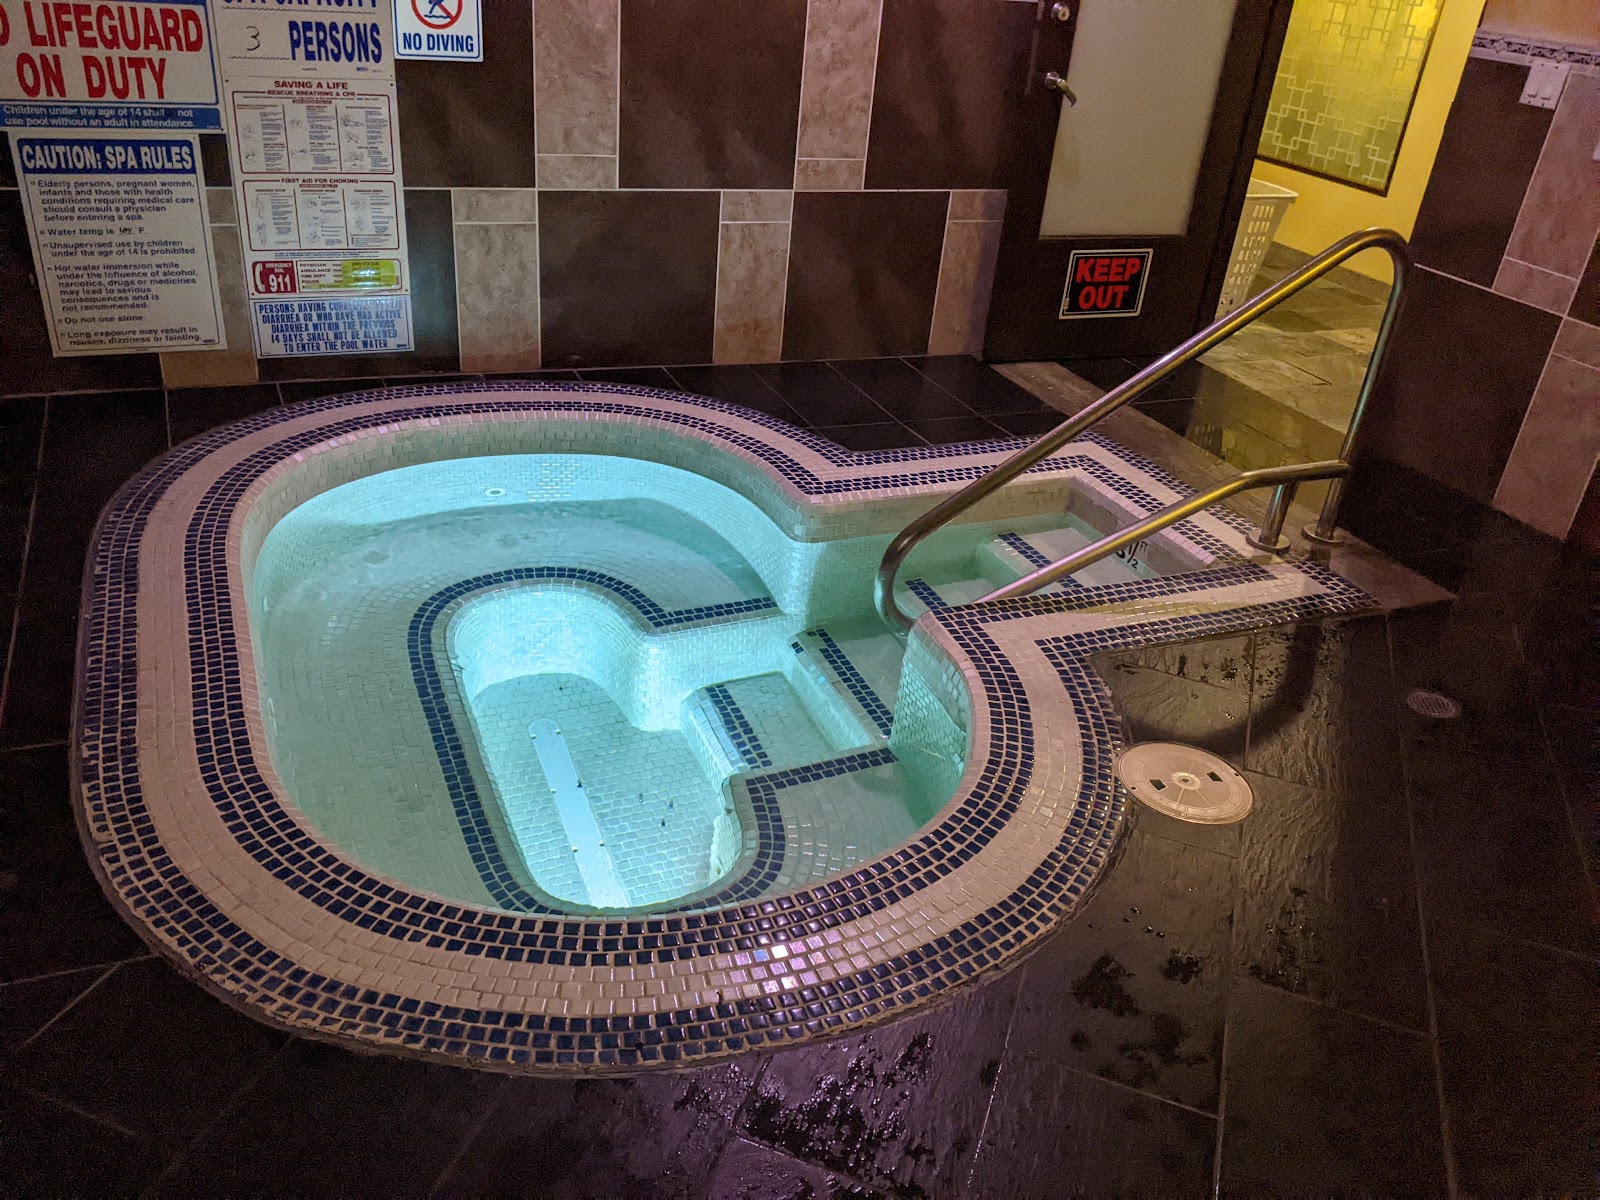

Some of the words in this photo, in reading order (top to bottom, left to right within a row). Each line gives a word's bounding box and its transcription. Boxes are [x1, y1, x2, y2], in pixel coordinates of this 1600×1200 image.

[24, 2, 203, 52] LIFEGUARD
[246, 26, 261, 51] 3
[288, 20, 383, 63] PERSONS
[403, 33, 422, 50] NO
[427, 34, 474, 52] DIVING
[17, 53, 67, 98] ON
[82, 55, 166, 99] DUTY
[274, 81, 313, 89] SAVING
[316, 81, 324, 89] A
[326, 82, 349, 90] LIFE
[3, 105, 47, 115] Children
[50, 107, 77, 115] under
[80, 107, 95, 115] the
[98, 108, 115, 117] age
[118, 108, 128, 116] of
[129, 108, 141, 116] 14
[143, 108, 165, 117] shall
[177, 109, 193, 117] not
[27, 117, 48, 127] pool
[51, 118, 88, 126] without
[104, 118, 128, 126] adult
[130, 119, 140, 127] in
[142, 119, 195, 127] attendance.
[22, 145, 102, 169] CAUTION:
[105, 146, 138, 169] SPA
[140, 146, 193, 169] RULES
[38, 180, 70, 190] Elderly
[74, 181, 114, 190] persons,
[117, 181, 157, 190] pregnant
[39, 188, 72, 196] infants
[75, 188, 91, 196] and
[95, 188, 120, 196] those
[124, 188, 142, 196] with
[145, 188, 173, 196] health
[94, 197, 135, 206] requiring
[43, 205, 75, 213] should
[78, 205, 113, 213] consult
[123, 205, 167, 214] physician
[44, 214, 74, 222] before
[77, 214, 115, 223] entering
[126, 215, 144, 223] spa.
[47, 228, 76, 236] Water
[79, 229, 104, 237] temp
[51, 239, 112, 249] Unsupervised
[134, 240, 145, 249] by
[147, 239, 182, 247] children
[52, 249, 79, 257] under
[97, 250, 114, 258] age
[54, 264, 71, 272] Hot
[1076, 258, 1141, 282] KEEP
[57, 272, 84, 280] under
[104, 271, 148, 279] influence
[150, 270, 160, 278] of
[162, 269, 198, 278] alcohol,
[59, 280, 105, 288] narcotics,
[108, 279, 135, 287] drugs
[268, 274, 292, 293] 911
[60, 289, 79, 297] may
[1079, 285, 1129, 309] OUT
[61, 295, 130, 304] consequences
[62, 304, 78, 312] not
[81, 302, 149, 311] recommended.
[259, 304, 295, 314] PERSONS
[298, 302, 326, 313] HAVING
[262, 313, 300, 324] DIARRHEA
[303, 312, 314, 323] OR
[316, 312, 333, 321] WHO
[335, 311, 355, 321] HAVE
[357, 310, 373, 320] HAD
[375, 309, 402, 319] ACTIVE
[271, 322, 309, 334] DIARRHEA
[312, 321, 340, 332] WITHIN
[343, 320, 356, 330] THE
[359, 319, 395, 330] PREVIOUS
[67, 331, 91, 339] Long
[94, 329, 137, 338] exposure
[139, 329, 158, 337] may
[161, 326, 186, 334] result
[271, 334, 280, 343] 14
[283, 332, 304, 343] DAYS
[307, 331, 331, 341] SHALL
[333, 331, 348, 340] NOT
[352, 330, 360, 339] BE
[363, 329, 397, 339] ALLOWED
[70, 338, 107, 346] nausea,
[109, 337, 151, 345] dizziness
[285, 343, 294, 353] TO
[296, 342, 321, 352] ENTER
[324, 341, 337, 351] THE
[341, 340, 359, 350] POOL
[362, 339, 388, 348] WATER
